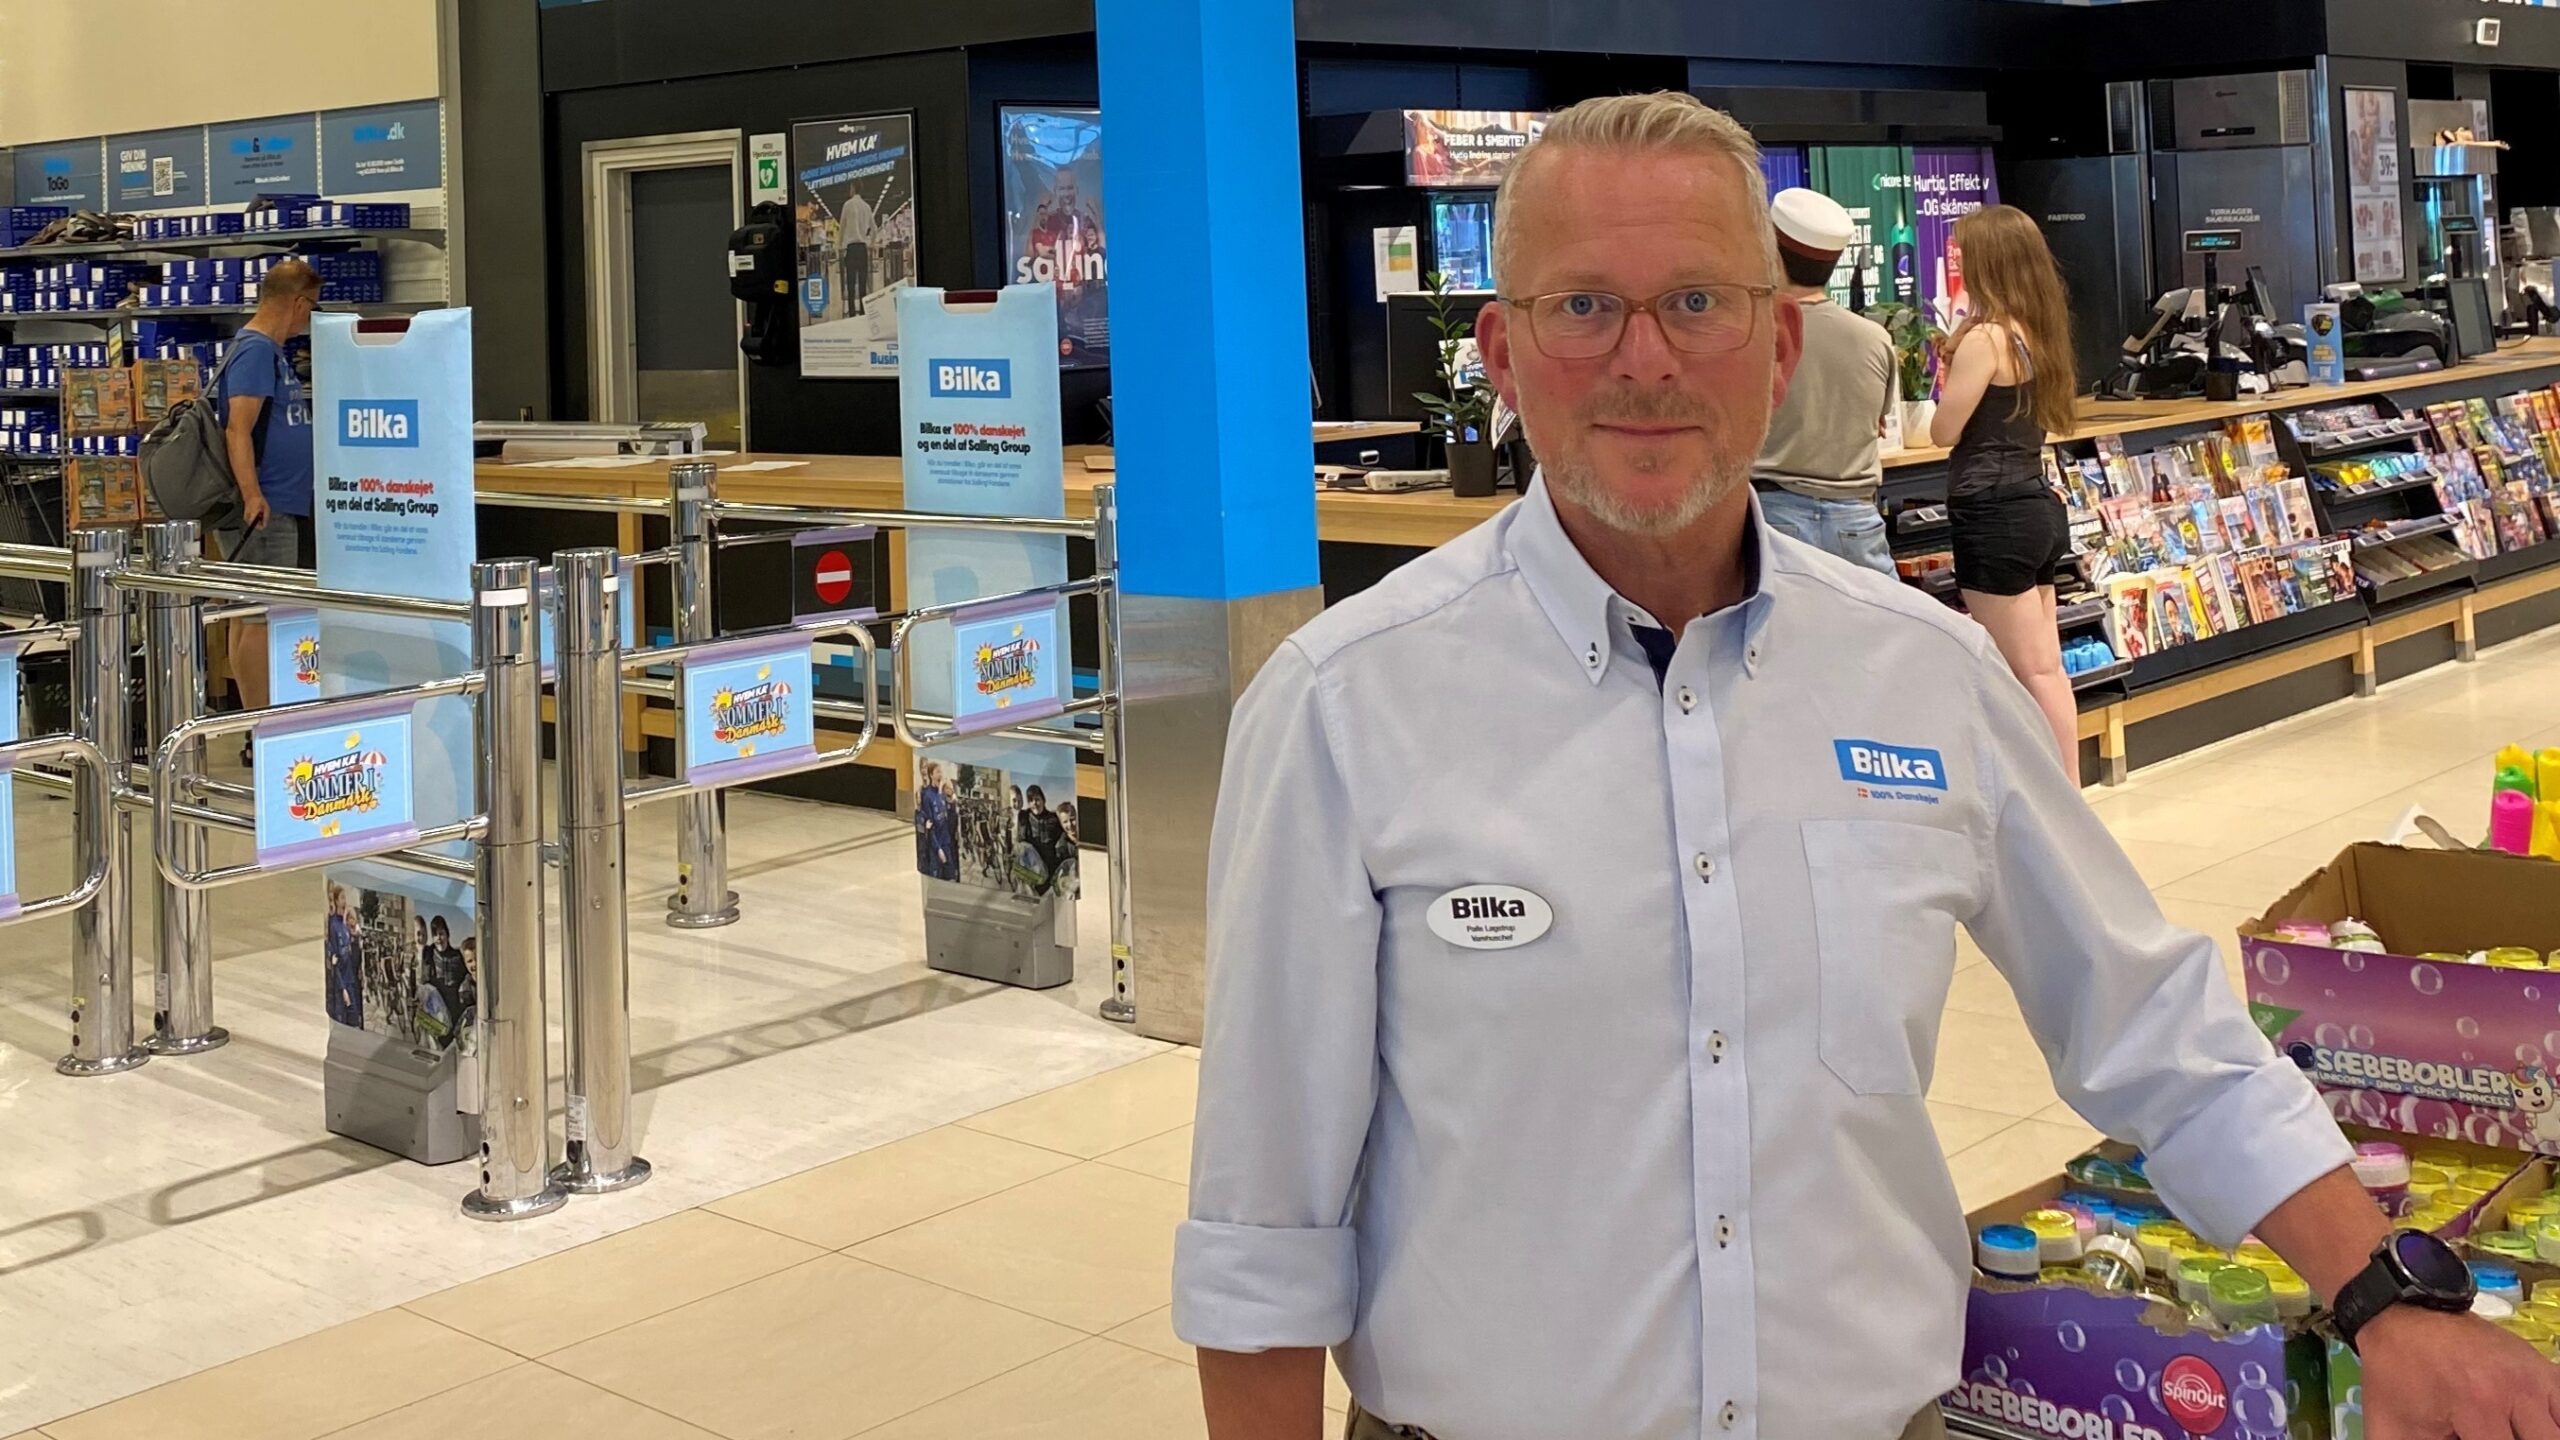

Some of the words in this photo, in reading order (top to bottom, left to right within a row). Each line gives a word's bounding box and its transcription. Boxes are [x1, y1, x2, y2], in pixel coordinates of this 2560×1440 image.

[826, 140, 858, 161] HVEM
[1443, 133, 1475, 147] FEBER
[1485, 134, 1526, 147] SMERTE?
[1880, 174, 1912, 188] nicorete
[2047, 213, 2087, 222] FASTFOOD
[2210, 208, 2253, 216] TØRKAGER
[1016, 239, 1108, 285] sallin
[938, 365, 1001, 392] Bilka
[347, 408, 409, 439] Bilka
[920, 422, 941, 434] Bilka
[943, 425, 952, 434] er
[953, 423, 978, 436] 100%
[980, 424, 1026, 439] danskejet
[917, 440, 929, 453] og
[930, 440, 942, 450] en
[943, 438, 957, 451] del
[957, 439, 967, 451] af
[968, 439, 999, 455] Salling
[1000, 440, 1031, 456] Group
[328, 476, 348, 491] Bilka
[349, 481, 358, 492] er
[359, 478, 385, 493] 100%
[386, 479, 434, 498] danskejet
[325, 498, 336, 513] og
[337, 500, 348, 511] en
[348, 496, 362, 511] del
[363, 497, 374, 511] af
[374, 497, 406, 516] Salling
[406, 498, 439, 518] Group
[981, 656, 1026, 682] SOMMER
[719, 699, 775, 728] SOMMER
[725, 713, 780, 743] Danmark
[313, 756, 342, 776] HVEM
[1849, 746, 1937, 781] Bilka
[296, 770, 364, 804] SOMMER
[366, 767, 376, 793] I
[1870, 790, 1894, 800] 100%
[1895, 791, 1940, 804] Danskejet
[304, 786, 374, 821] Danmark
[1451, 896, 1526, 919] Bilka
[2314, 1048, 2511, 1095] SÆBEBOBLER
[2319, 1071, 2366, 1087] UNICORN
[2375, 1079, 2402, 1092] DINO
[2412, 1085, 2448, 1098] SPACE
[2458, 1091, 2511, 1107] PRINCESS
[2164, 1381, 2226, 1409] SpinOut
